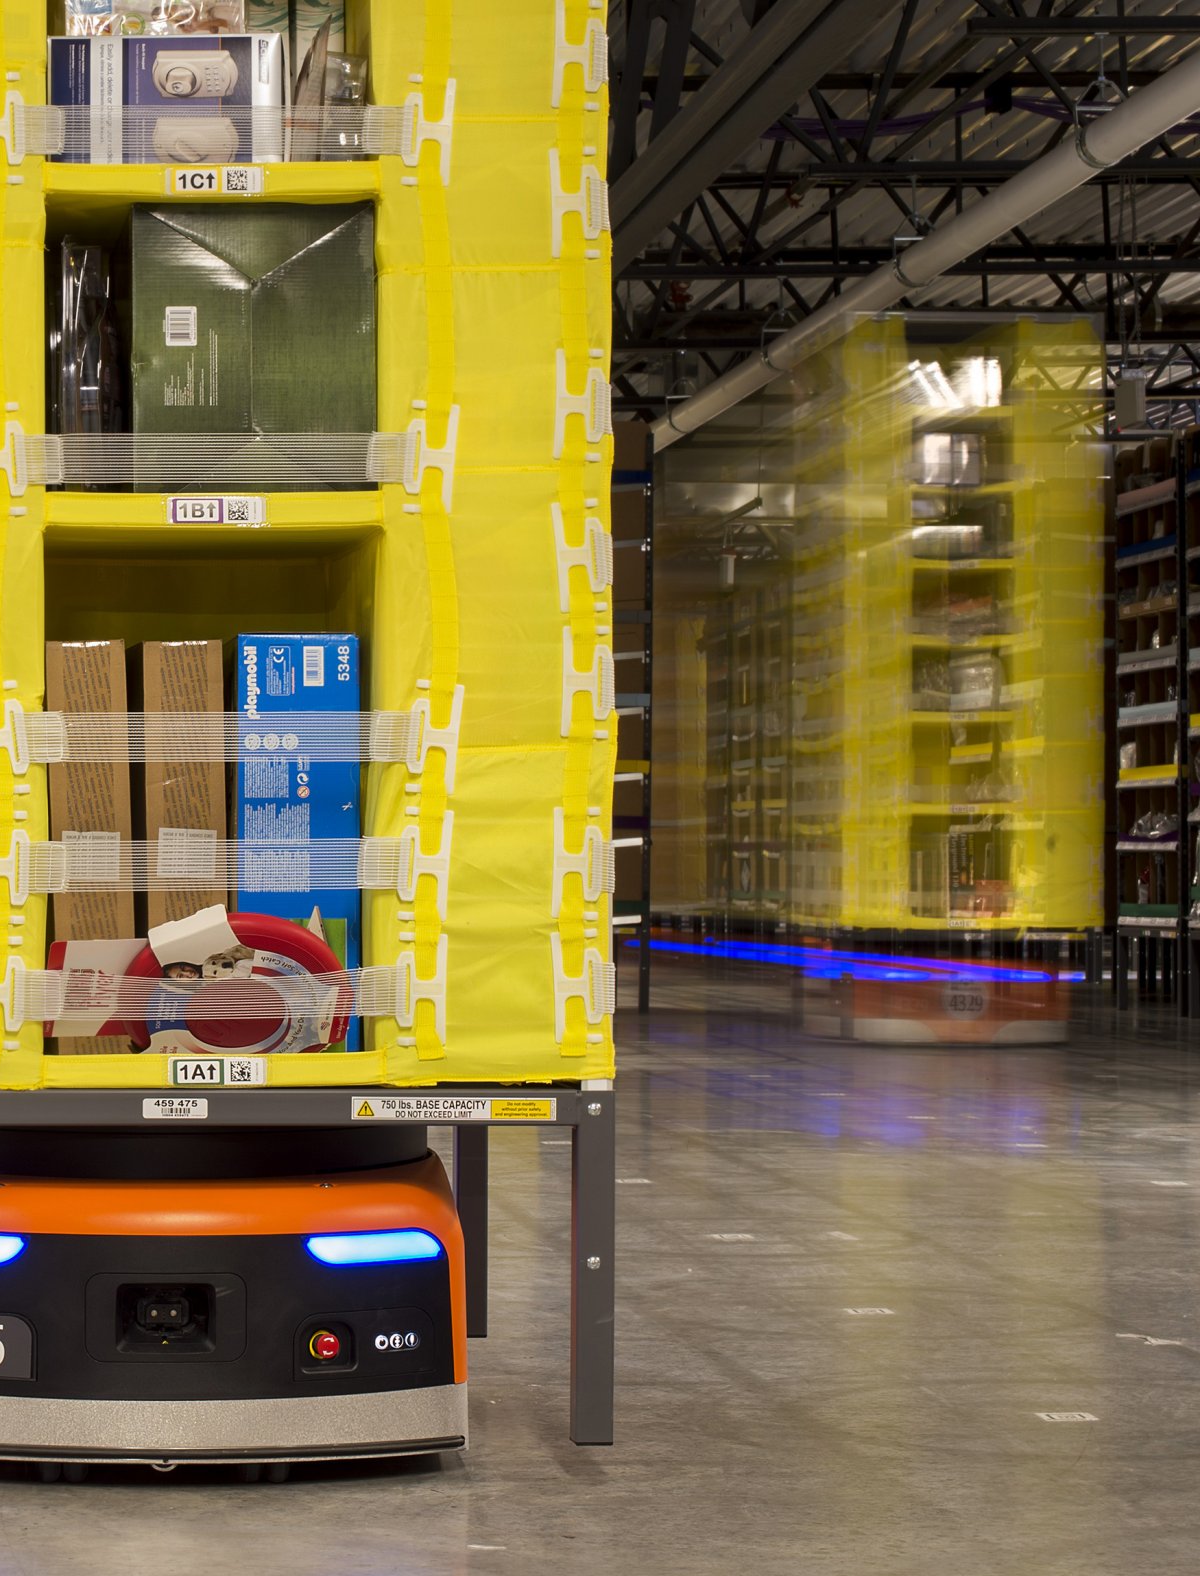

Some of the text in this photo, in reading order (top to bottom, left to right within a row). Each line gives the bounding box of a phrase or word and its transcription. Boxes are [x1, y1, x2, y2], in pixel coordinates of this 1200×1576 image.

[338, 645, 350, 682] 5348
[244, 646, 260, 720] playmobil
[950, 994, 984, 1012] 4329
[154, 1100, 198, 1108] 459 475
[381, 1100, 486, 1110] 750 lbs. BASE CAPACITY
[395, 1110, 472, 1118] DO NOT EXCEED LIMIT
